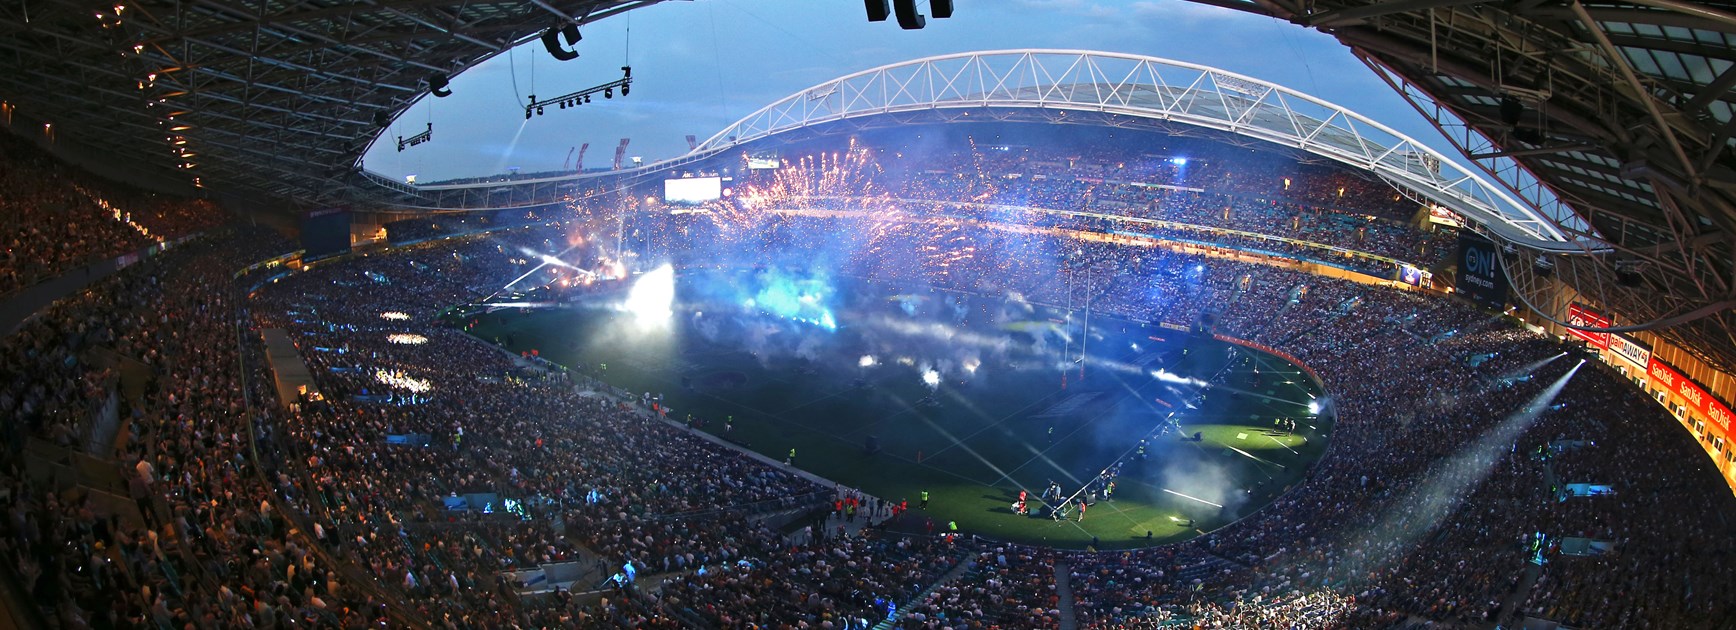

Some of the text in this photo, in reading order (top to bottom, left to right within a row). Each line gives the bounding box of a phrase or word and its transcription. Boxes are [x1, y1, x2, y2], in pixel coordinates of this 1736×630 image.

[1465, 247, 1495, 278] ON!
[1465, 274, 1494, 289] sydney.com
[1652, 363, 1674, 387] SanDisk
[1680, 381, 1703, 407] SanDisk
[1707, 402, 1732, 431] SanDisk
